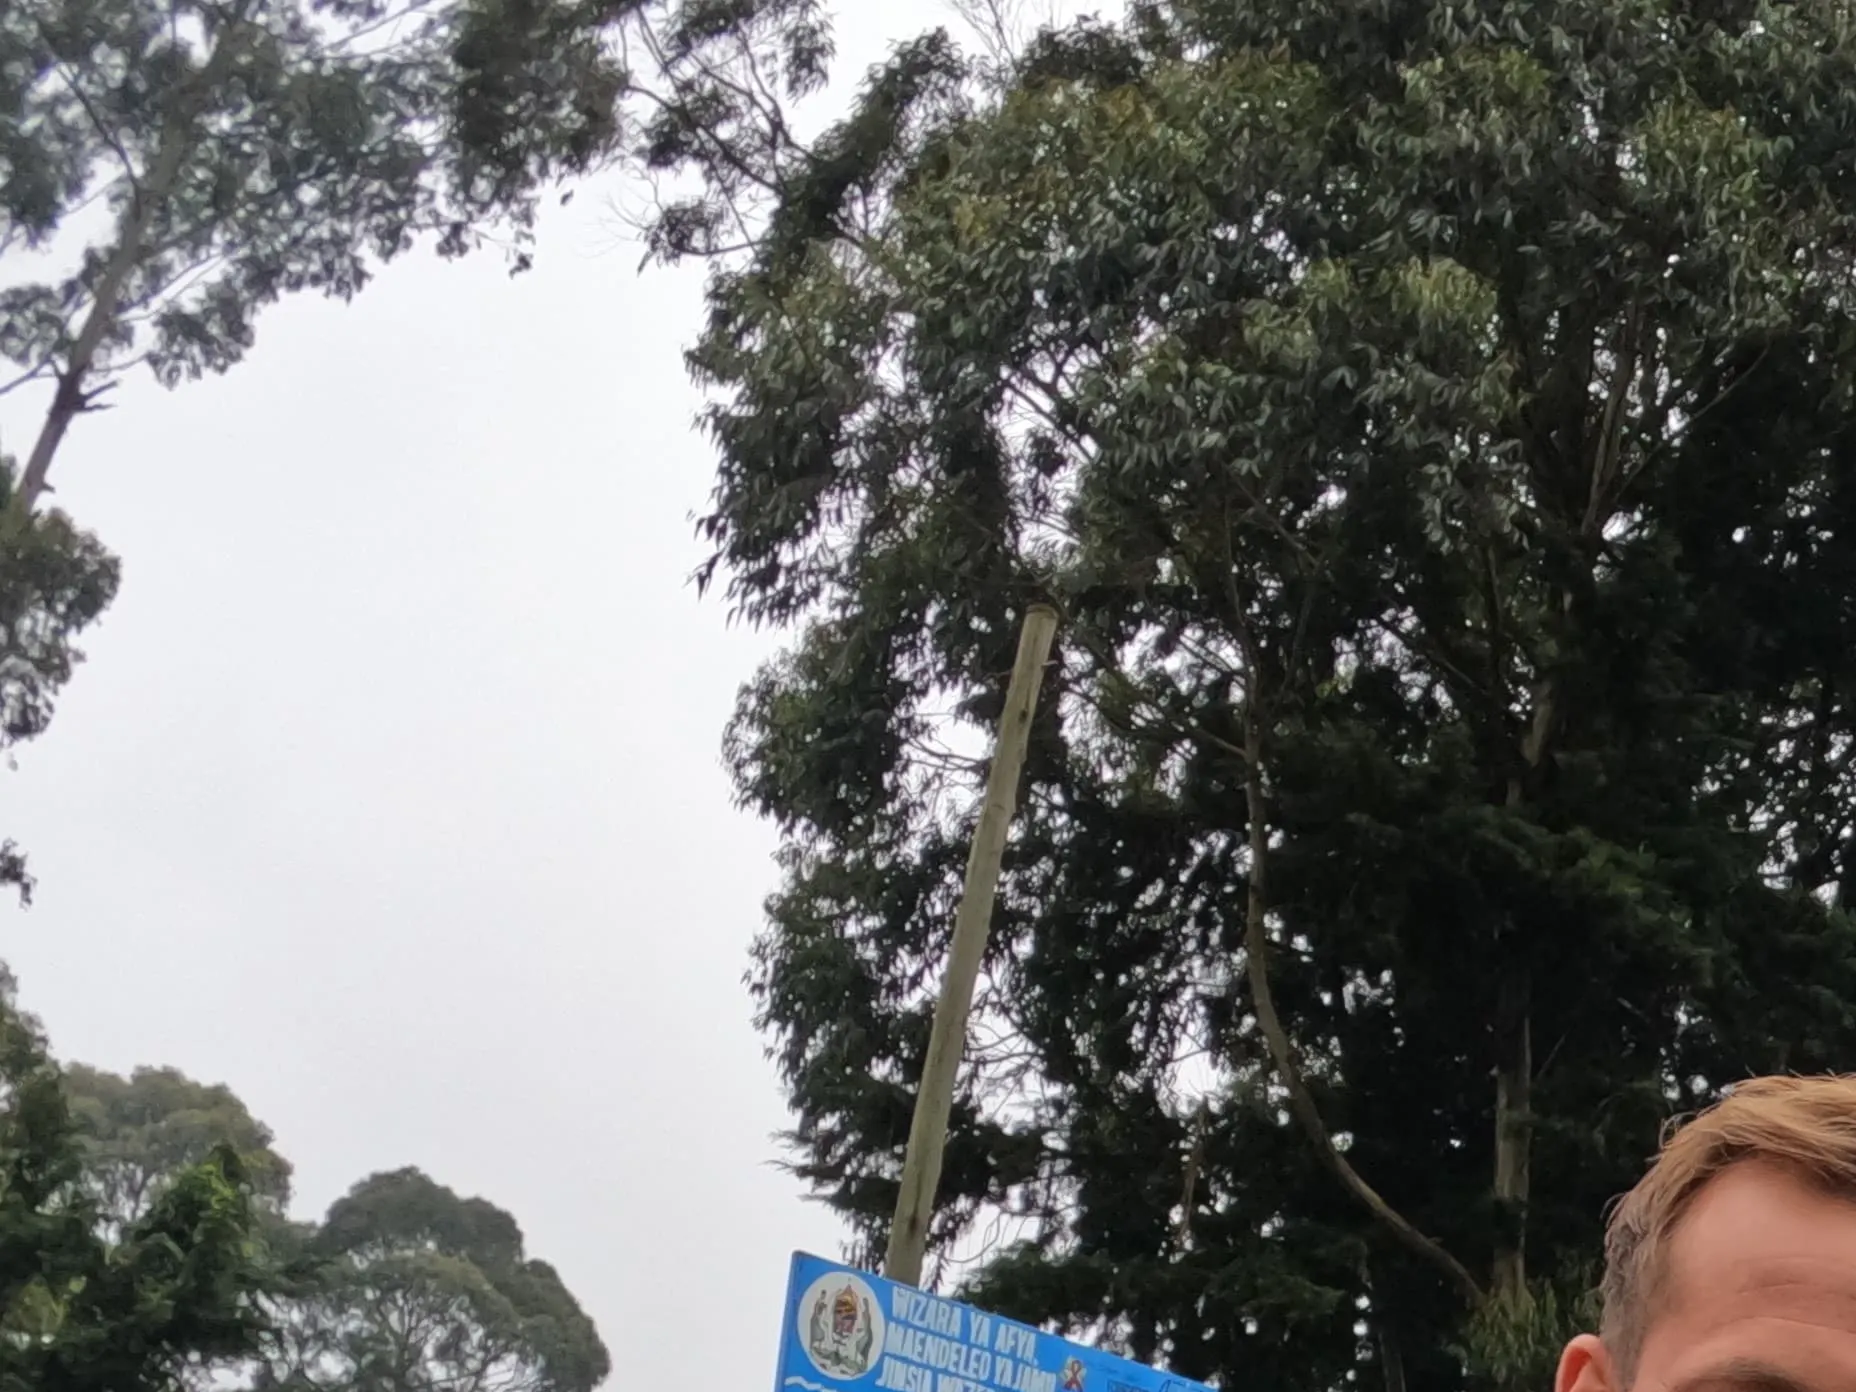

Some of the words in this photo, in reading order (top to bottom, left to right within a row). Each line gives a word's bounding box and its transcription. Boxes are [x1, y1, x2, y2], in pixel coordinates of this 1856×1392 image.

[892, 1286, 962, 1338] WIZARA
[969, 1311, 991, 1347] YA
[884, 1321, 992, 1381] MAENDELEO
